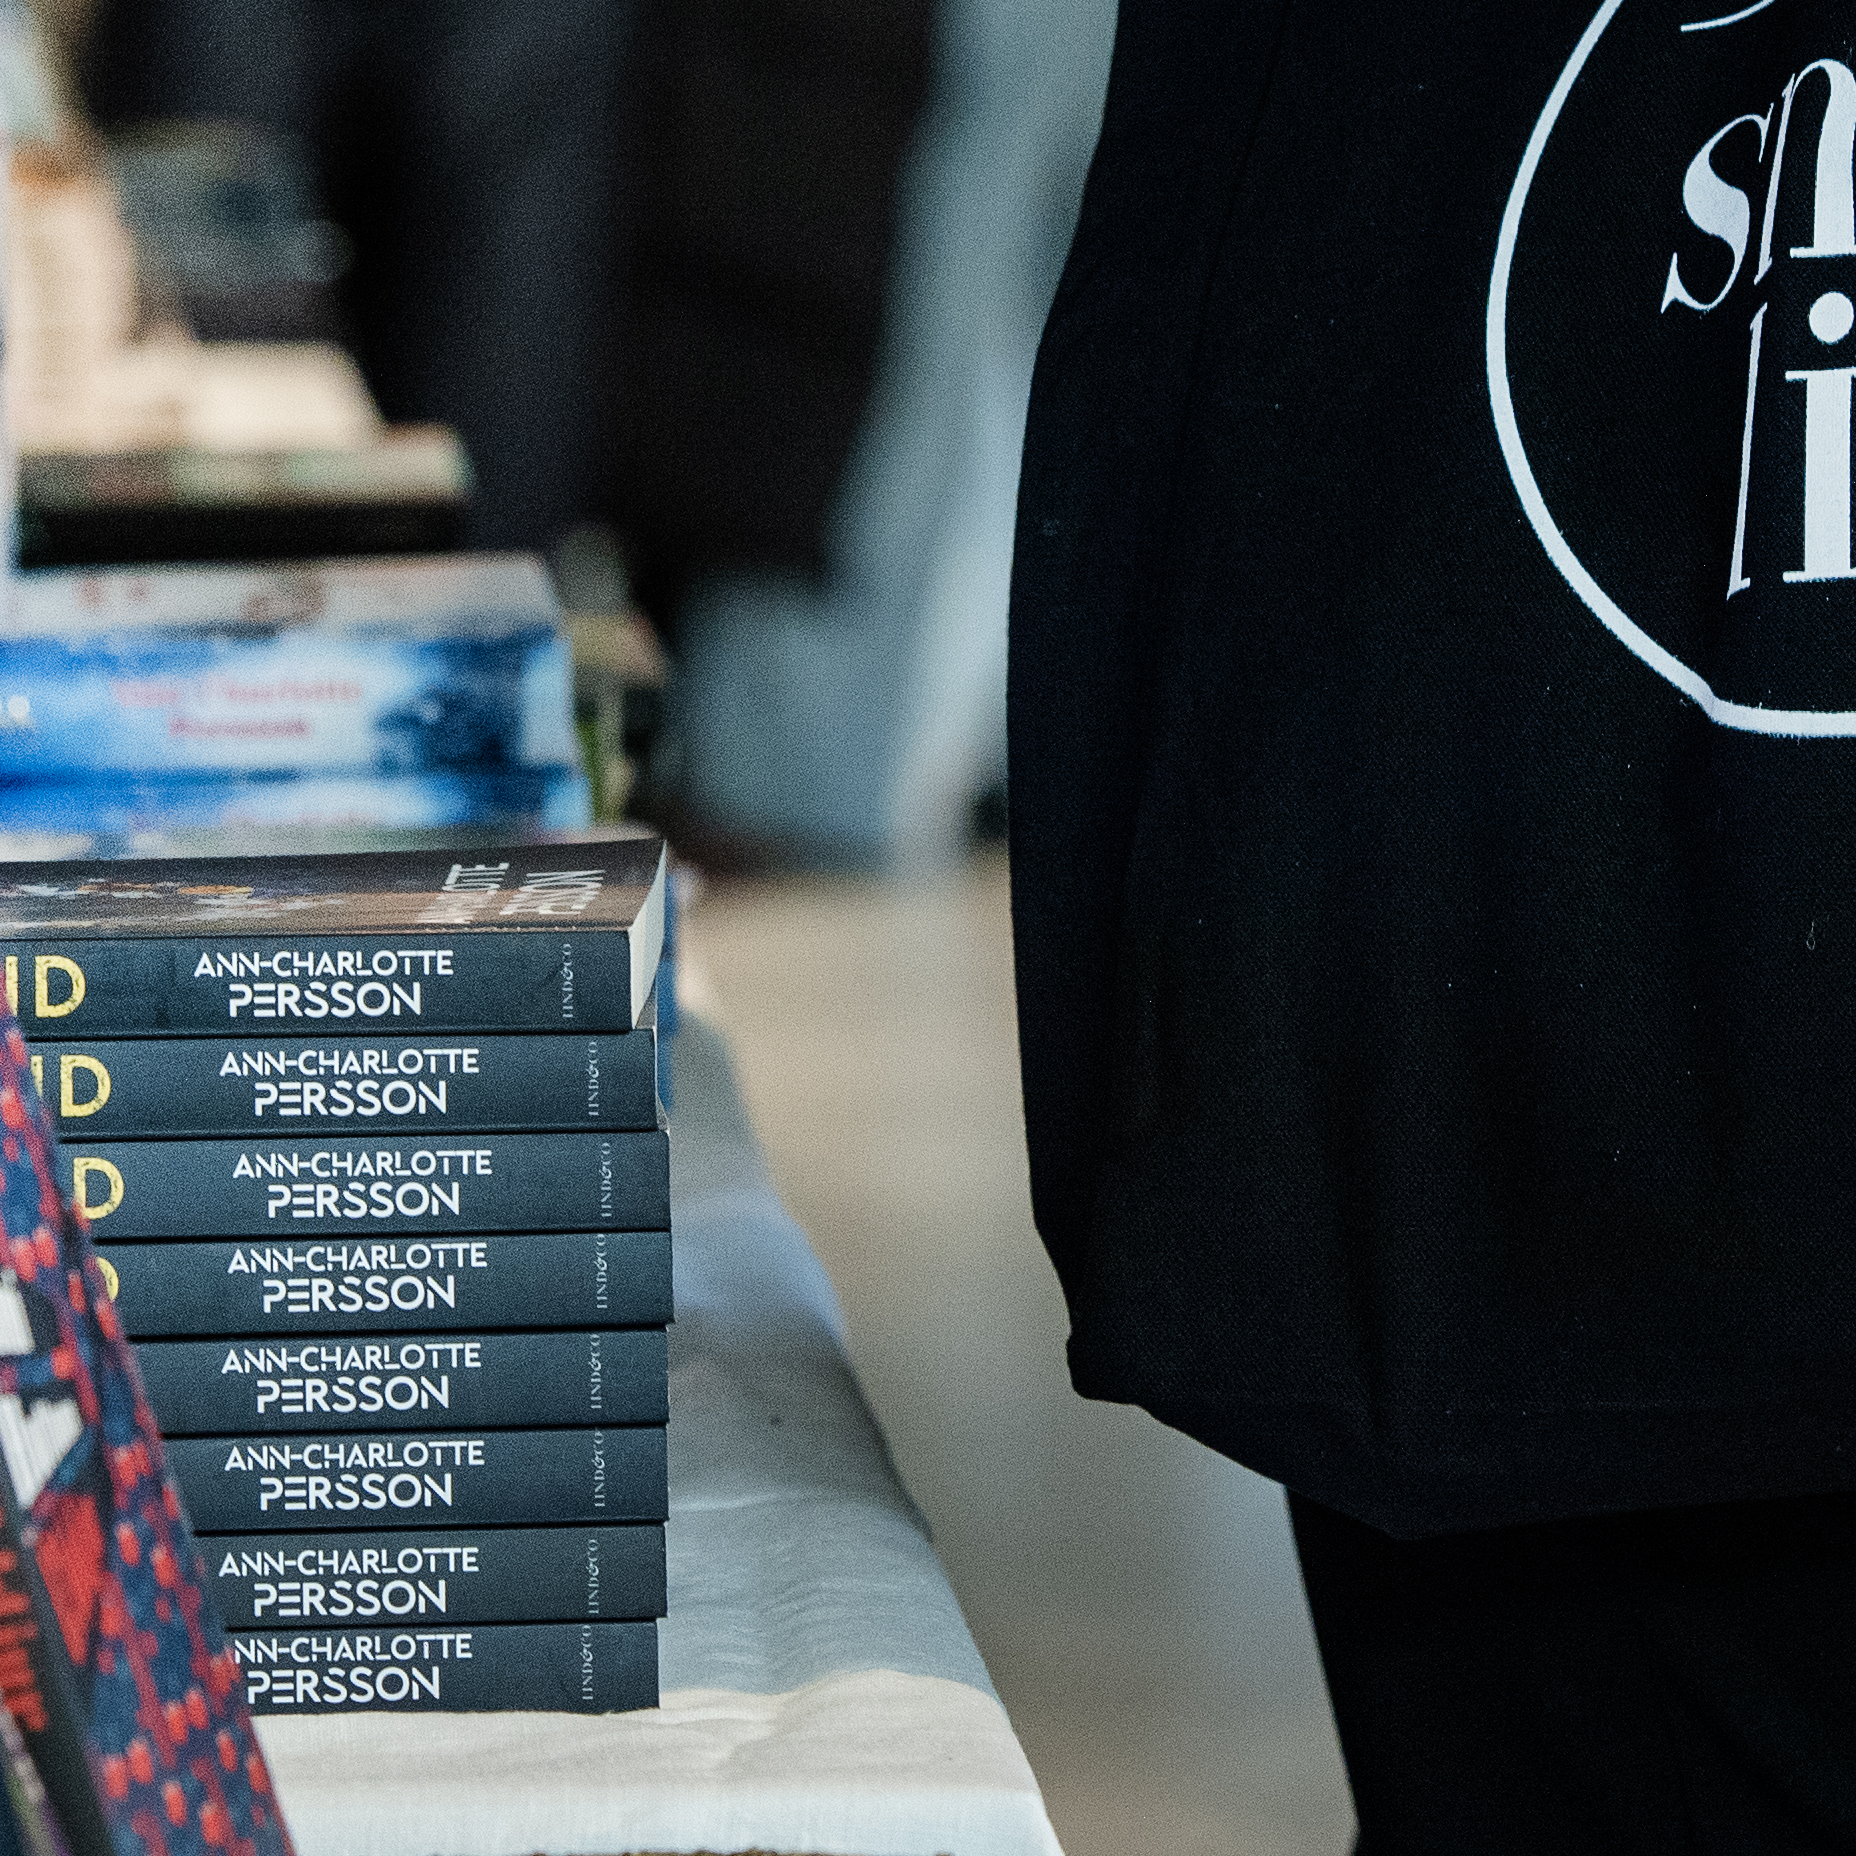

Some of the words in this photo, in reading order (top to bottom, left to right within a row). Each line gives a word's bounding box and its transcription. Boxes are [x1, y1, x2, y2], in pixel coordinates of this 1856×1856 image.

[194, 950, 453, 977] ANN-CHARLOTTE
[229, 981, 421, 1018] PERSSON
[219, 1048, 479, 1076] ANN-CHARLOTTE
[255, 1080, 446, 1116] PERSSON
[232, 1149, 492, 1178] ANN-CHARLOTTE
[268, 1181, 459, 1218] PERSSON
[228, 1242, 487, 1271] ANN-CHARLOTTE
[263, 1275, 455, 1313] PERSSON
[221, 1342, 481, 1372] ANN-CHARLOTTE
[257, 1375, 448, 1413] PERSSON
[225, 1440, 484, 1470] ANN-CHARLOTTE
[260, 1473, 452, 1510] PERSSON
[219, 1547, 478, 1576] ANN-CHARLOTTE
[254, 1580, 446, 1616] PERSSON
[232, 1633, 472, 1662] NN-CHARLOTTE
[248, 1666, 439, 1704] PERSSON
